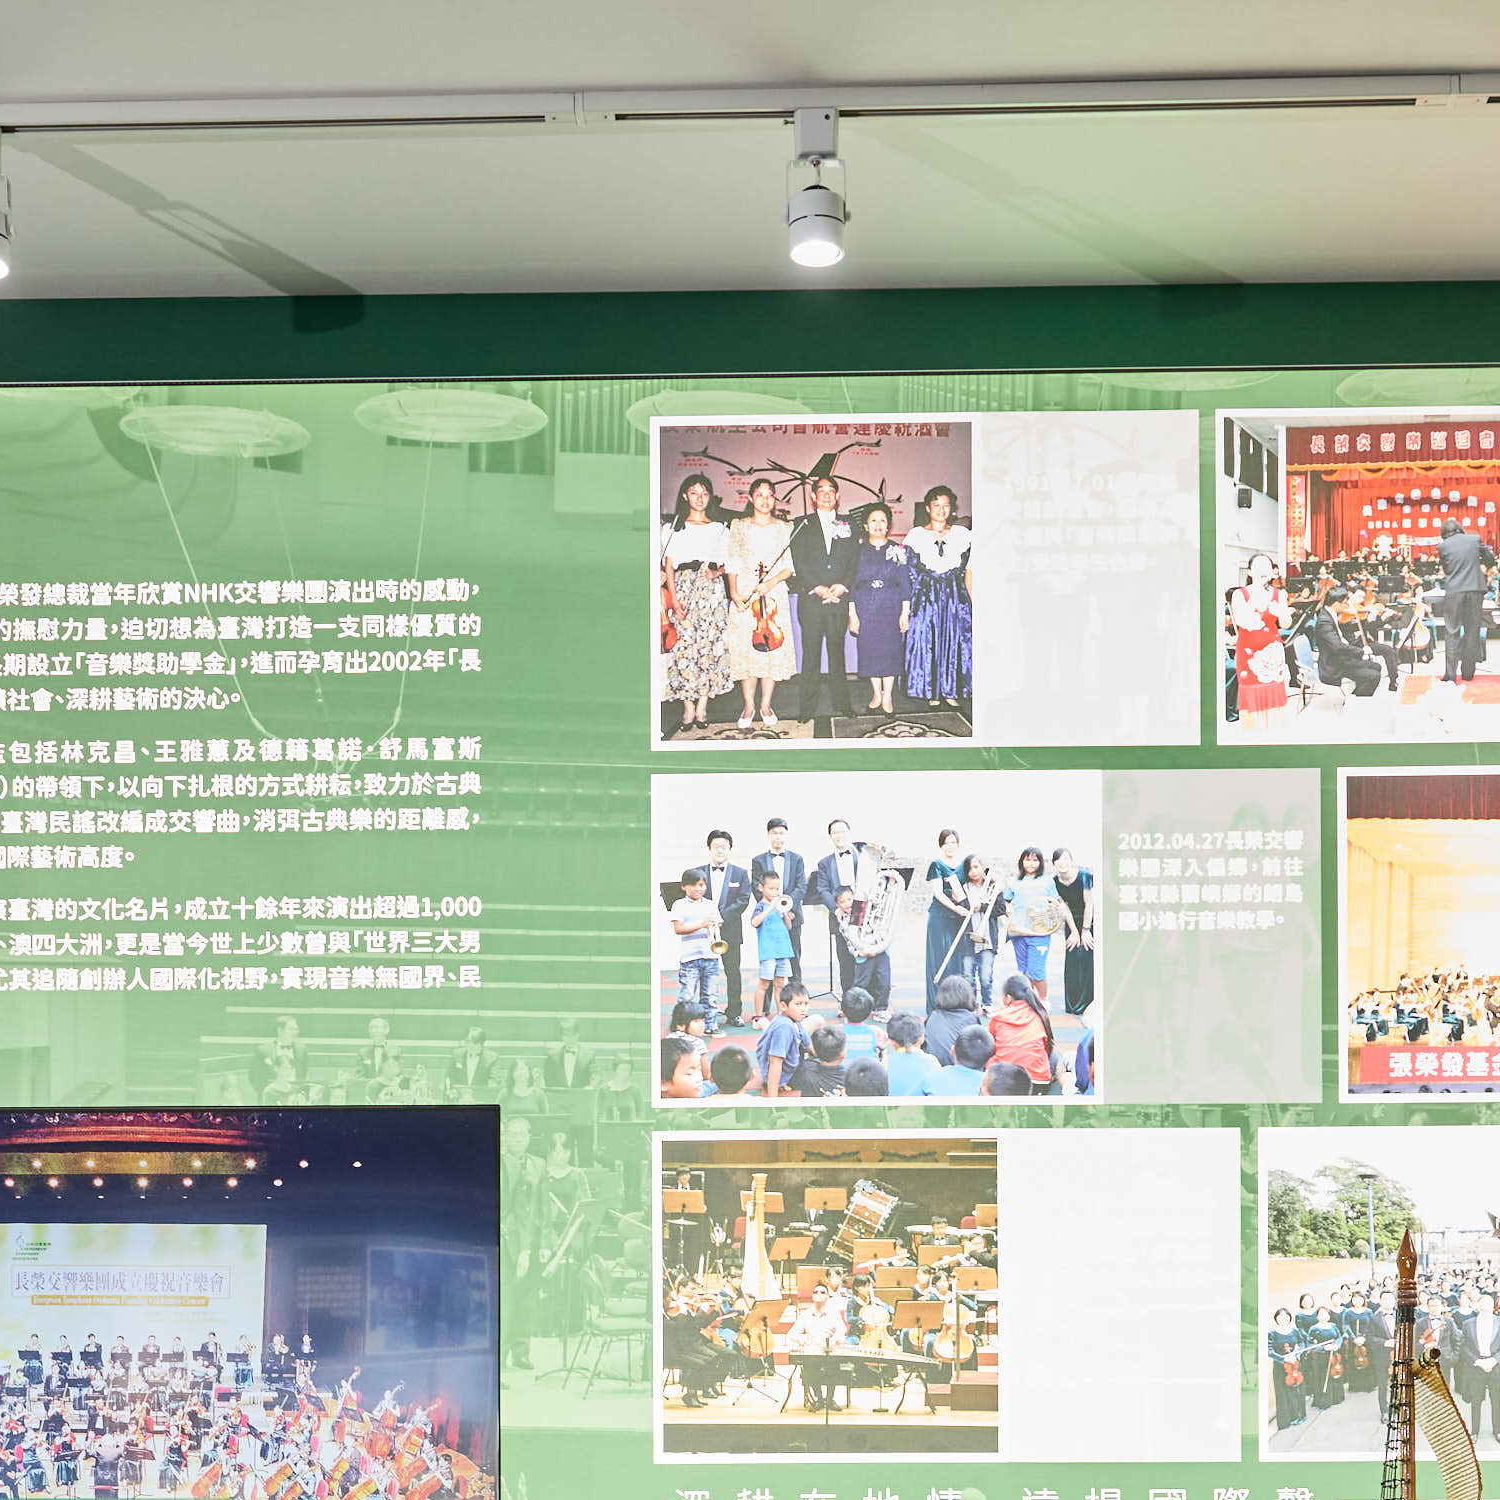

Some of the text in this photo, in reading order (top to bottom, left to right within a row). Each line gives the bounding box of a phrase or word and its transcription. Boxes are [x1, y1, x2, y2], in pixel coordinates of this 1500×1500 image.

[15, 1271, 224, 1293] 長榮交響樂團成立慶祝音樂會
